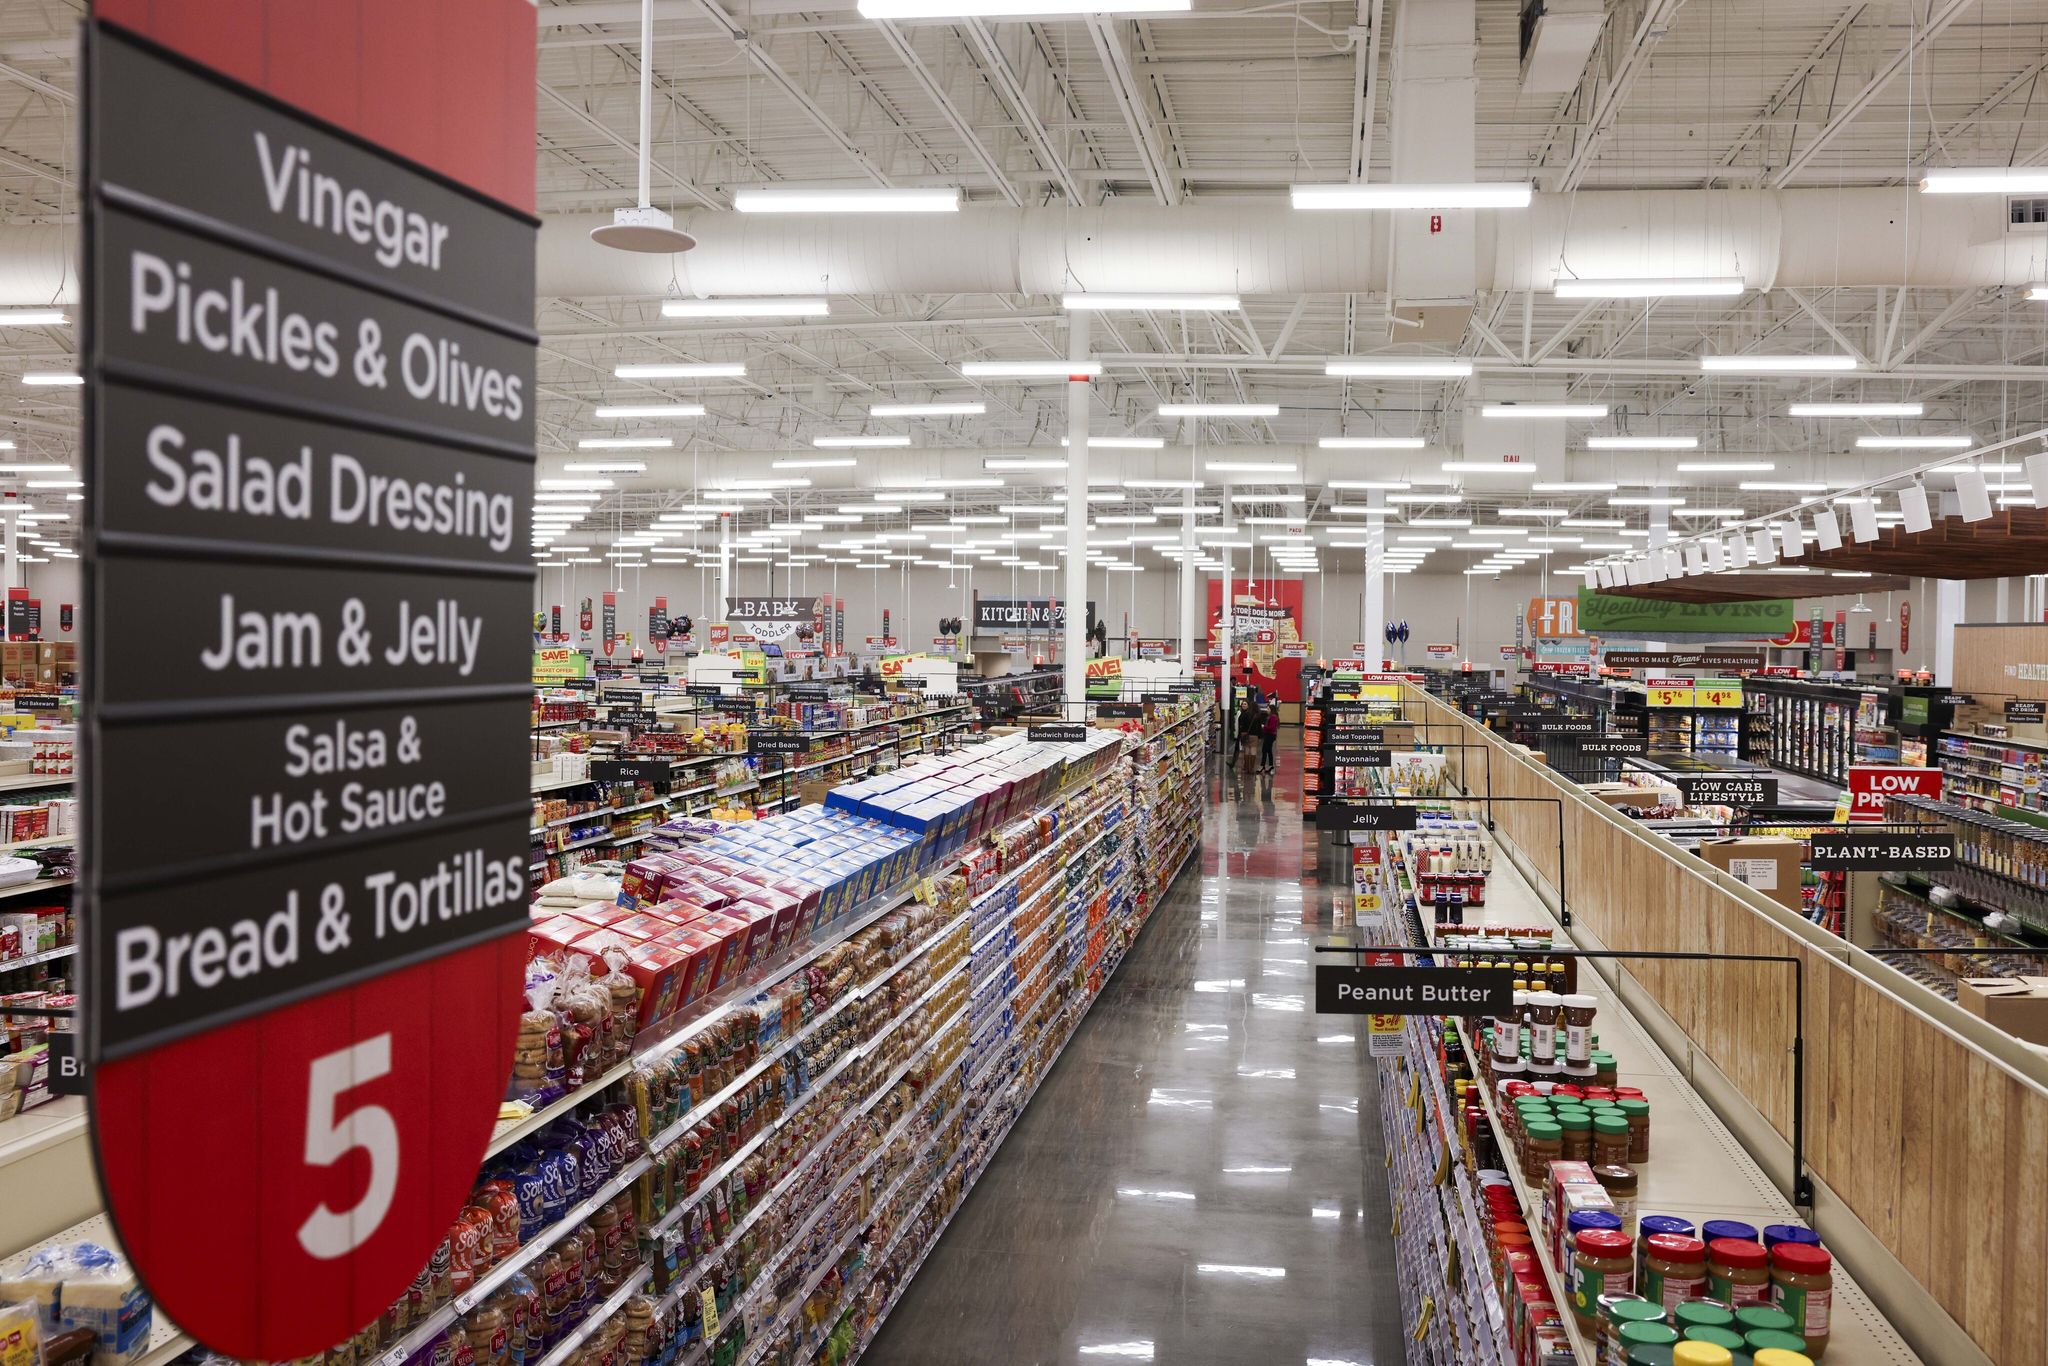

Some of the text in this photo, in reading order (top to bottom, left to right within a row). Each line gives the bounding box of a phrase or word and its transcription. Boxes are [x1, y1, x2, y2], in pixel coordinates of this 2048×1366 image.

[254, 132, 448, 270] Vinegar
[131, 251, 524, 422] Pickles & Olives
[146, 424, 514, 553] Salad Dressing
[1679, 603, 1785, 618] LIVING
[202, 594, 482, 676] Jam & Jelly
[750, 623, 792, 638] TODDLER
[541, 650, 568, 660] SAVE!
[1030, 731, 1084, 739] Sandwich Bread
[285, 716, 421, 777] Salsa &
[1582, 743, 1642, 752] BULK FOODS
[1335, 755, 1380, 764] Mayonnaise
[620, 767, 640, 776] Rice
[1691, 782, 1763, 792] LOW CARB
[1870, 775, 1920, 791] LOW
[1690, 792, 1765, 803] LIFESTYLE
[251, 780, 446, 850] Hot Sauce
[1352, 814, 1379, 825] Jelly
[1814, 846, 1952, 859] PLANT-BASED
[116, 849, 524, 1012] Bread & Tortillas
[778, 920, 793, 934] flavor
[751, 931, 768, 947] flavor
[1338, 983, 1492, 1002] Peanut Butter
[297, 1031, 401, 1261] 5
